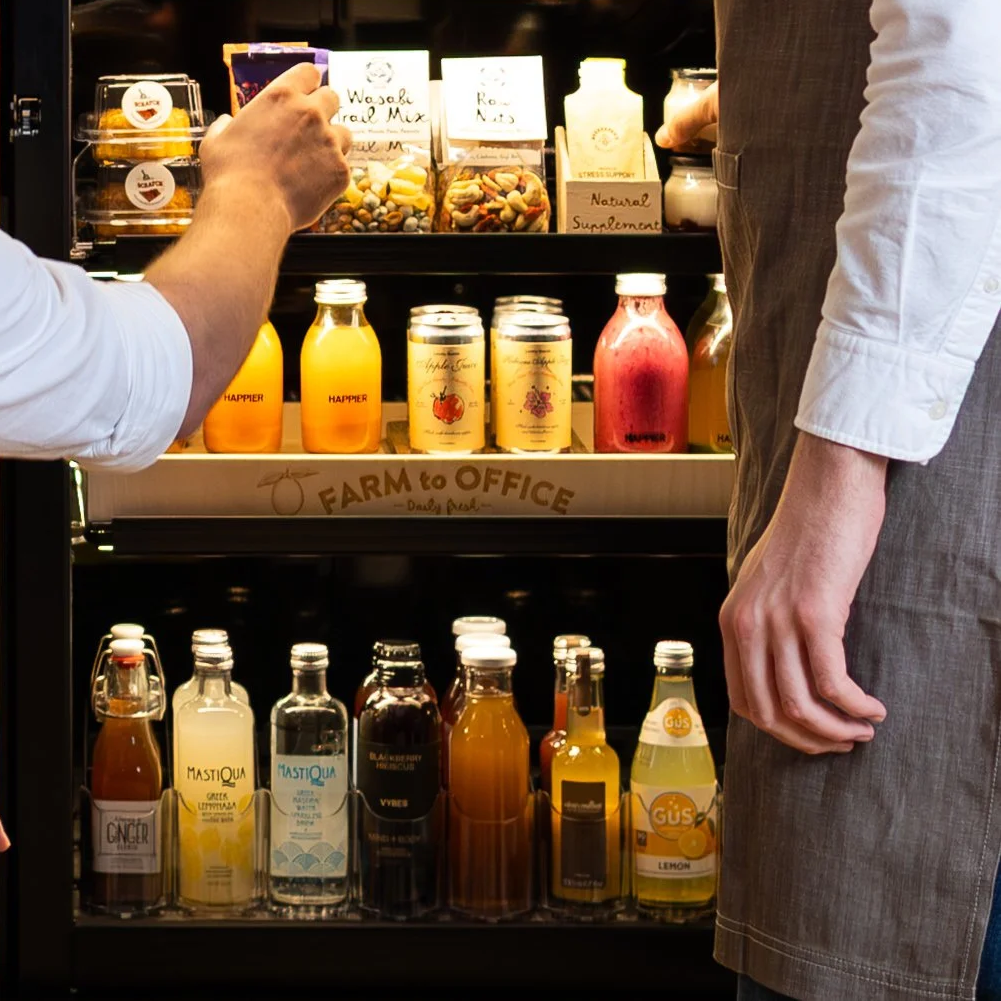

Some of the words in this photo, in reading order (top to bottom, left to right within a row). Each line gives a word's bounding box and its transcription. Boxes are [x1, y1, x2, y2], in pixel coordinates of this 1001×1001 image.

[347, 88, 414, 105] Wasabi
[386, 106, 429, 124] Mix
[590, 193, 651, 208] Natural
[224, 394, 264, 402] HAPPIER
[328, 394, 368, 403] HAPPIER
[318, 467, 412, 515] FARM
[419, 470, 447, 490] to
[454, 465, 575, 515] OFFICE
[658, 861, 691, 871] LEMON
